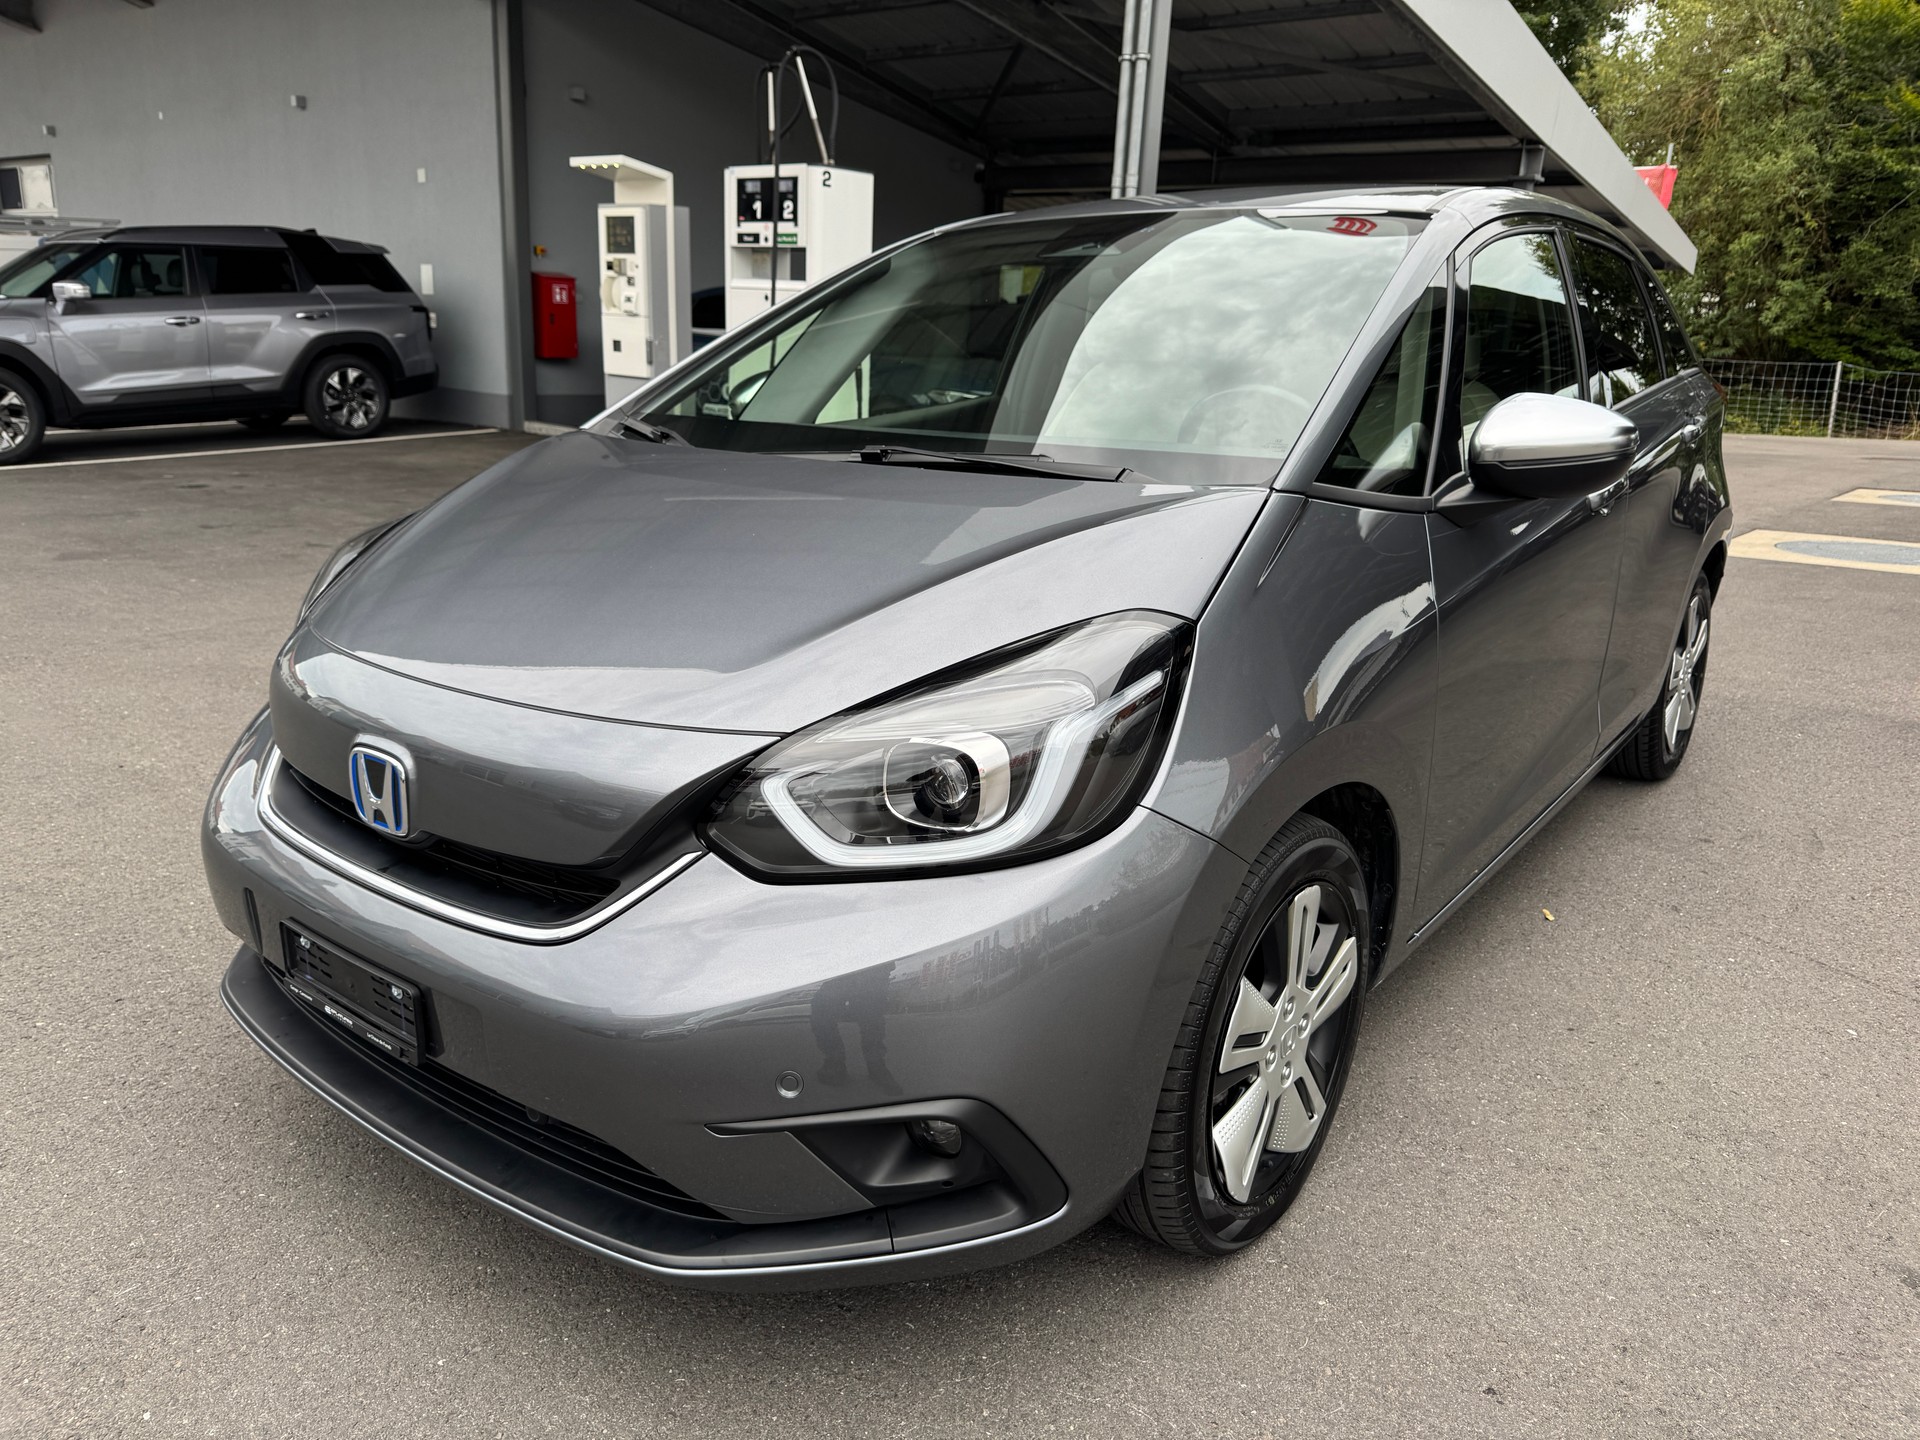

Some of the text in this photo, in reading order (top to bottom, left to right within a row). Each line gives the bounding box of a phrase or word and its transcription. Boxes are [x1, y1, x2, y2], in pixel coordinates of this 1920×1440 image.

[822, 170, 832, 187] 2
[752, 199, 794, 220] 1 2
